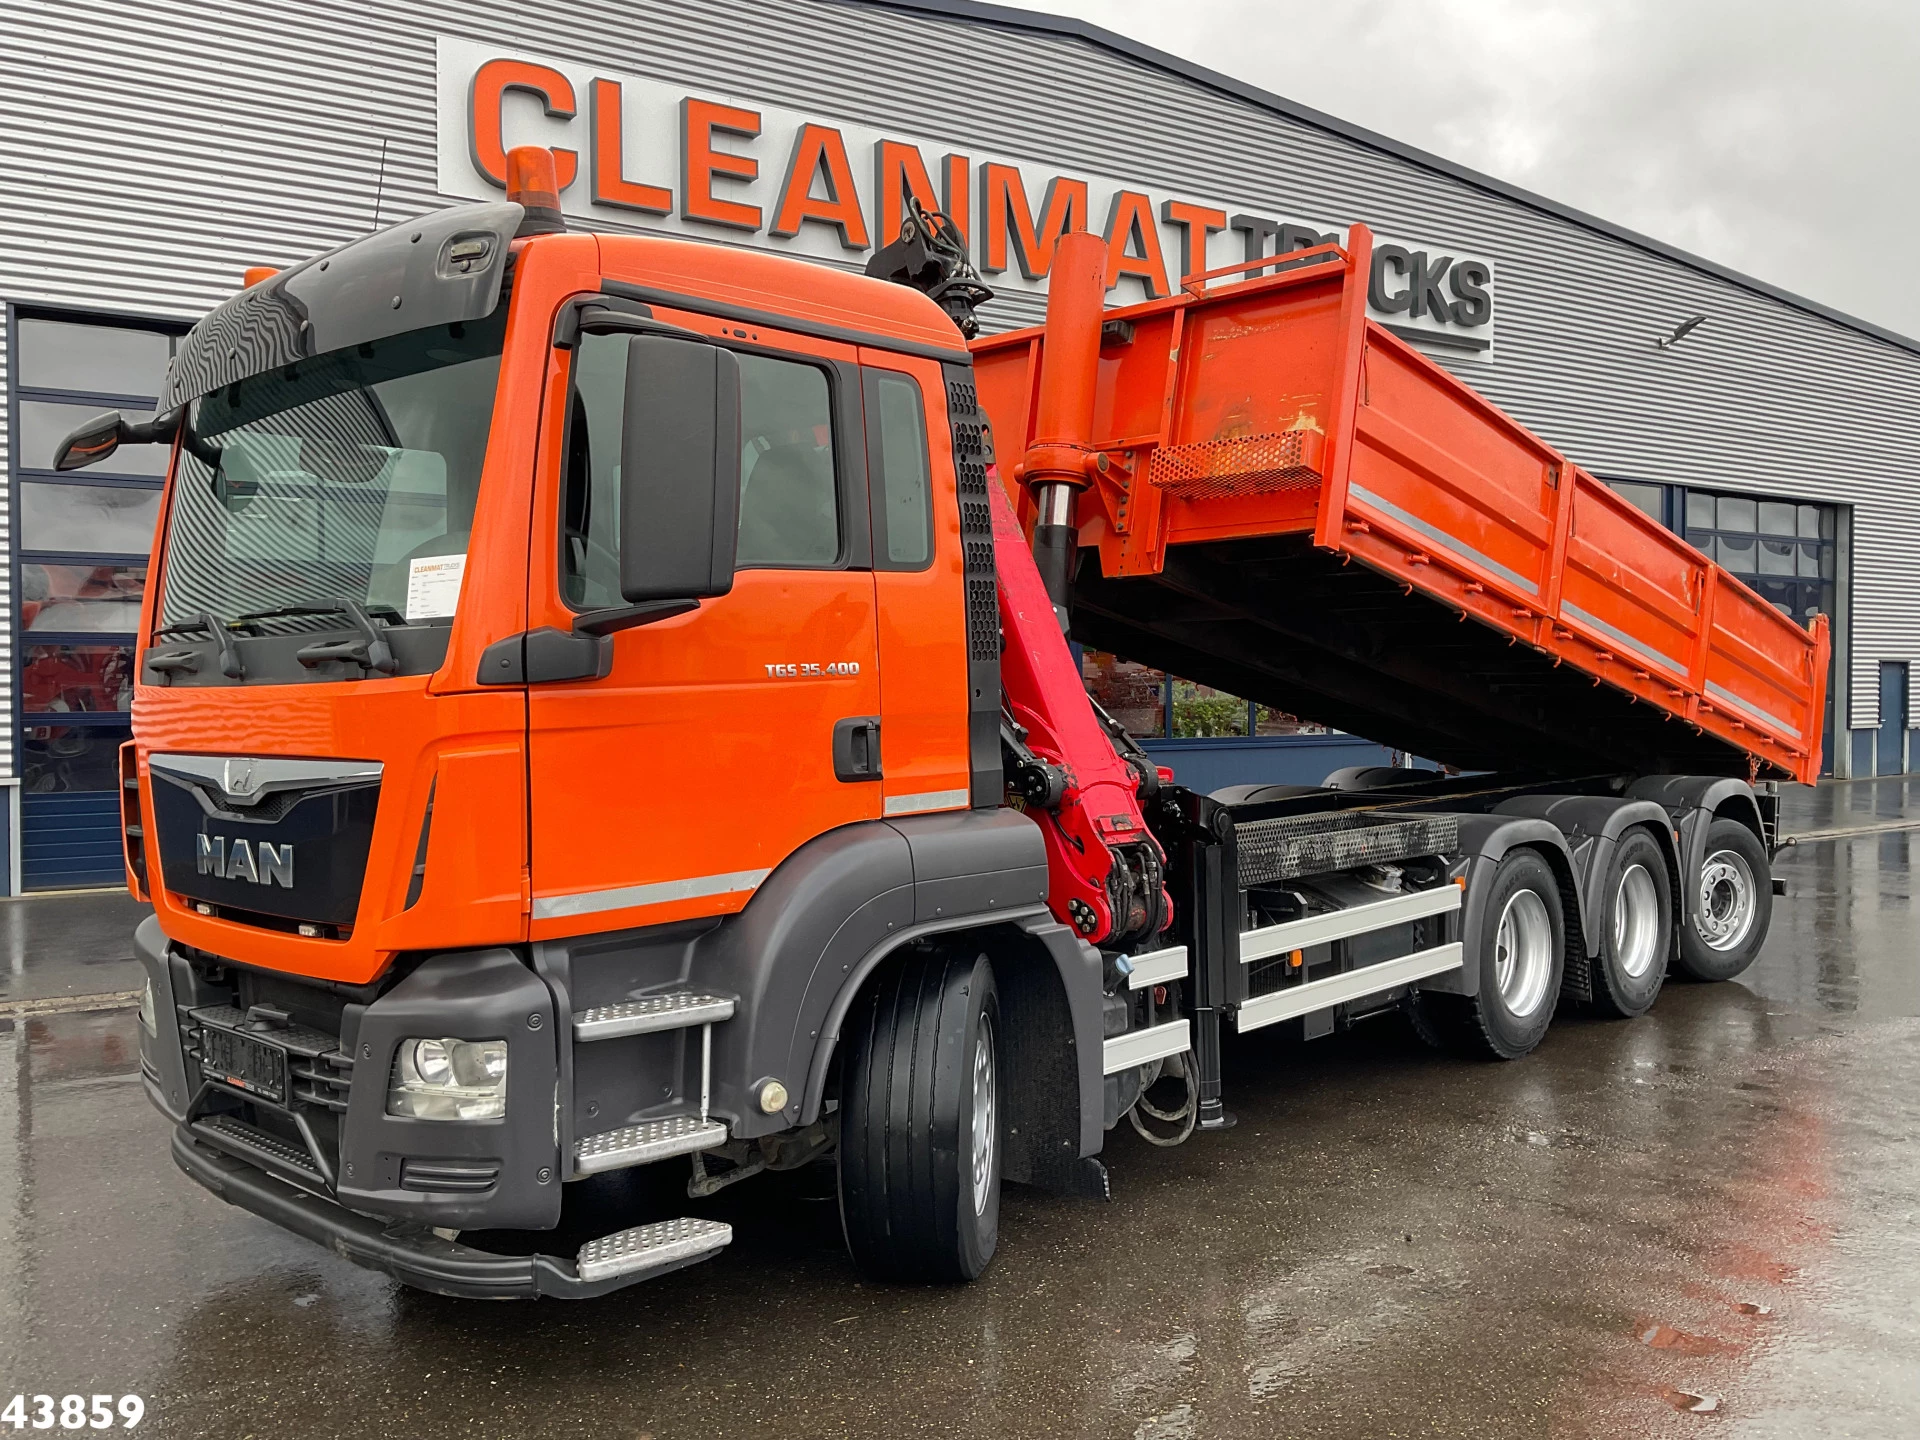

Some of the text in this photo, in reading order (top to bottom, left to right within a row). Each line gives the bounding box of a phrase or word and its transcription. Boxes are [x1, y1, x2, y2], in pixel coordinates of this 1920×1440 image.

[1230, 214, 1491, 327] TRCKS
[765, 661, 860, 678] TGS 35.400
[197, 833, 294, 889] MAN
